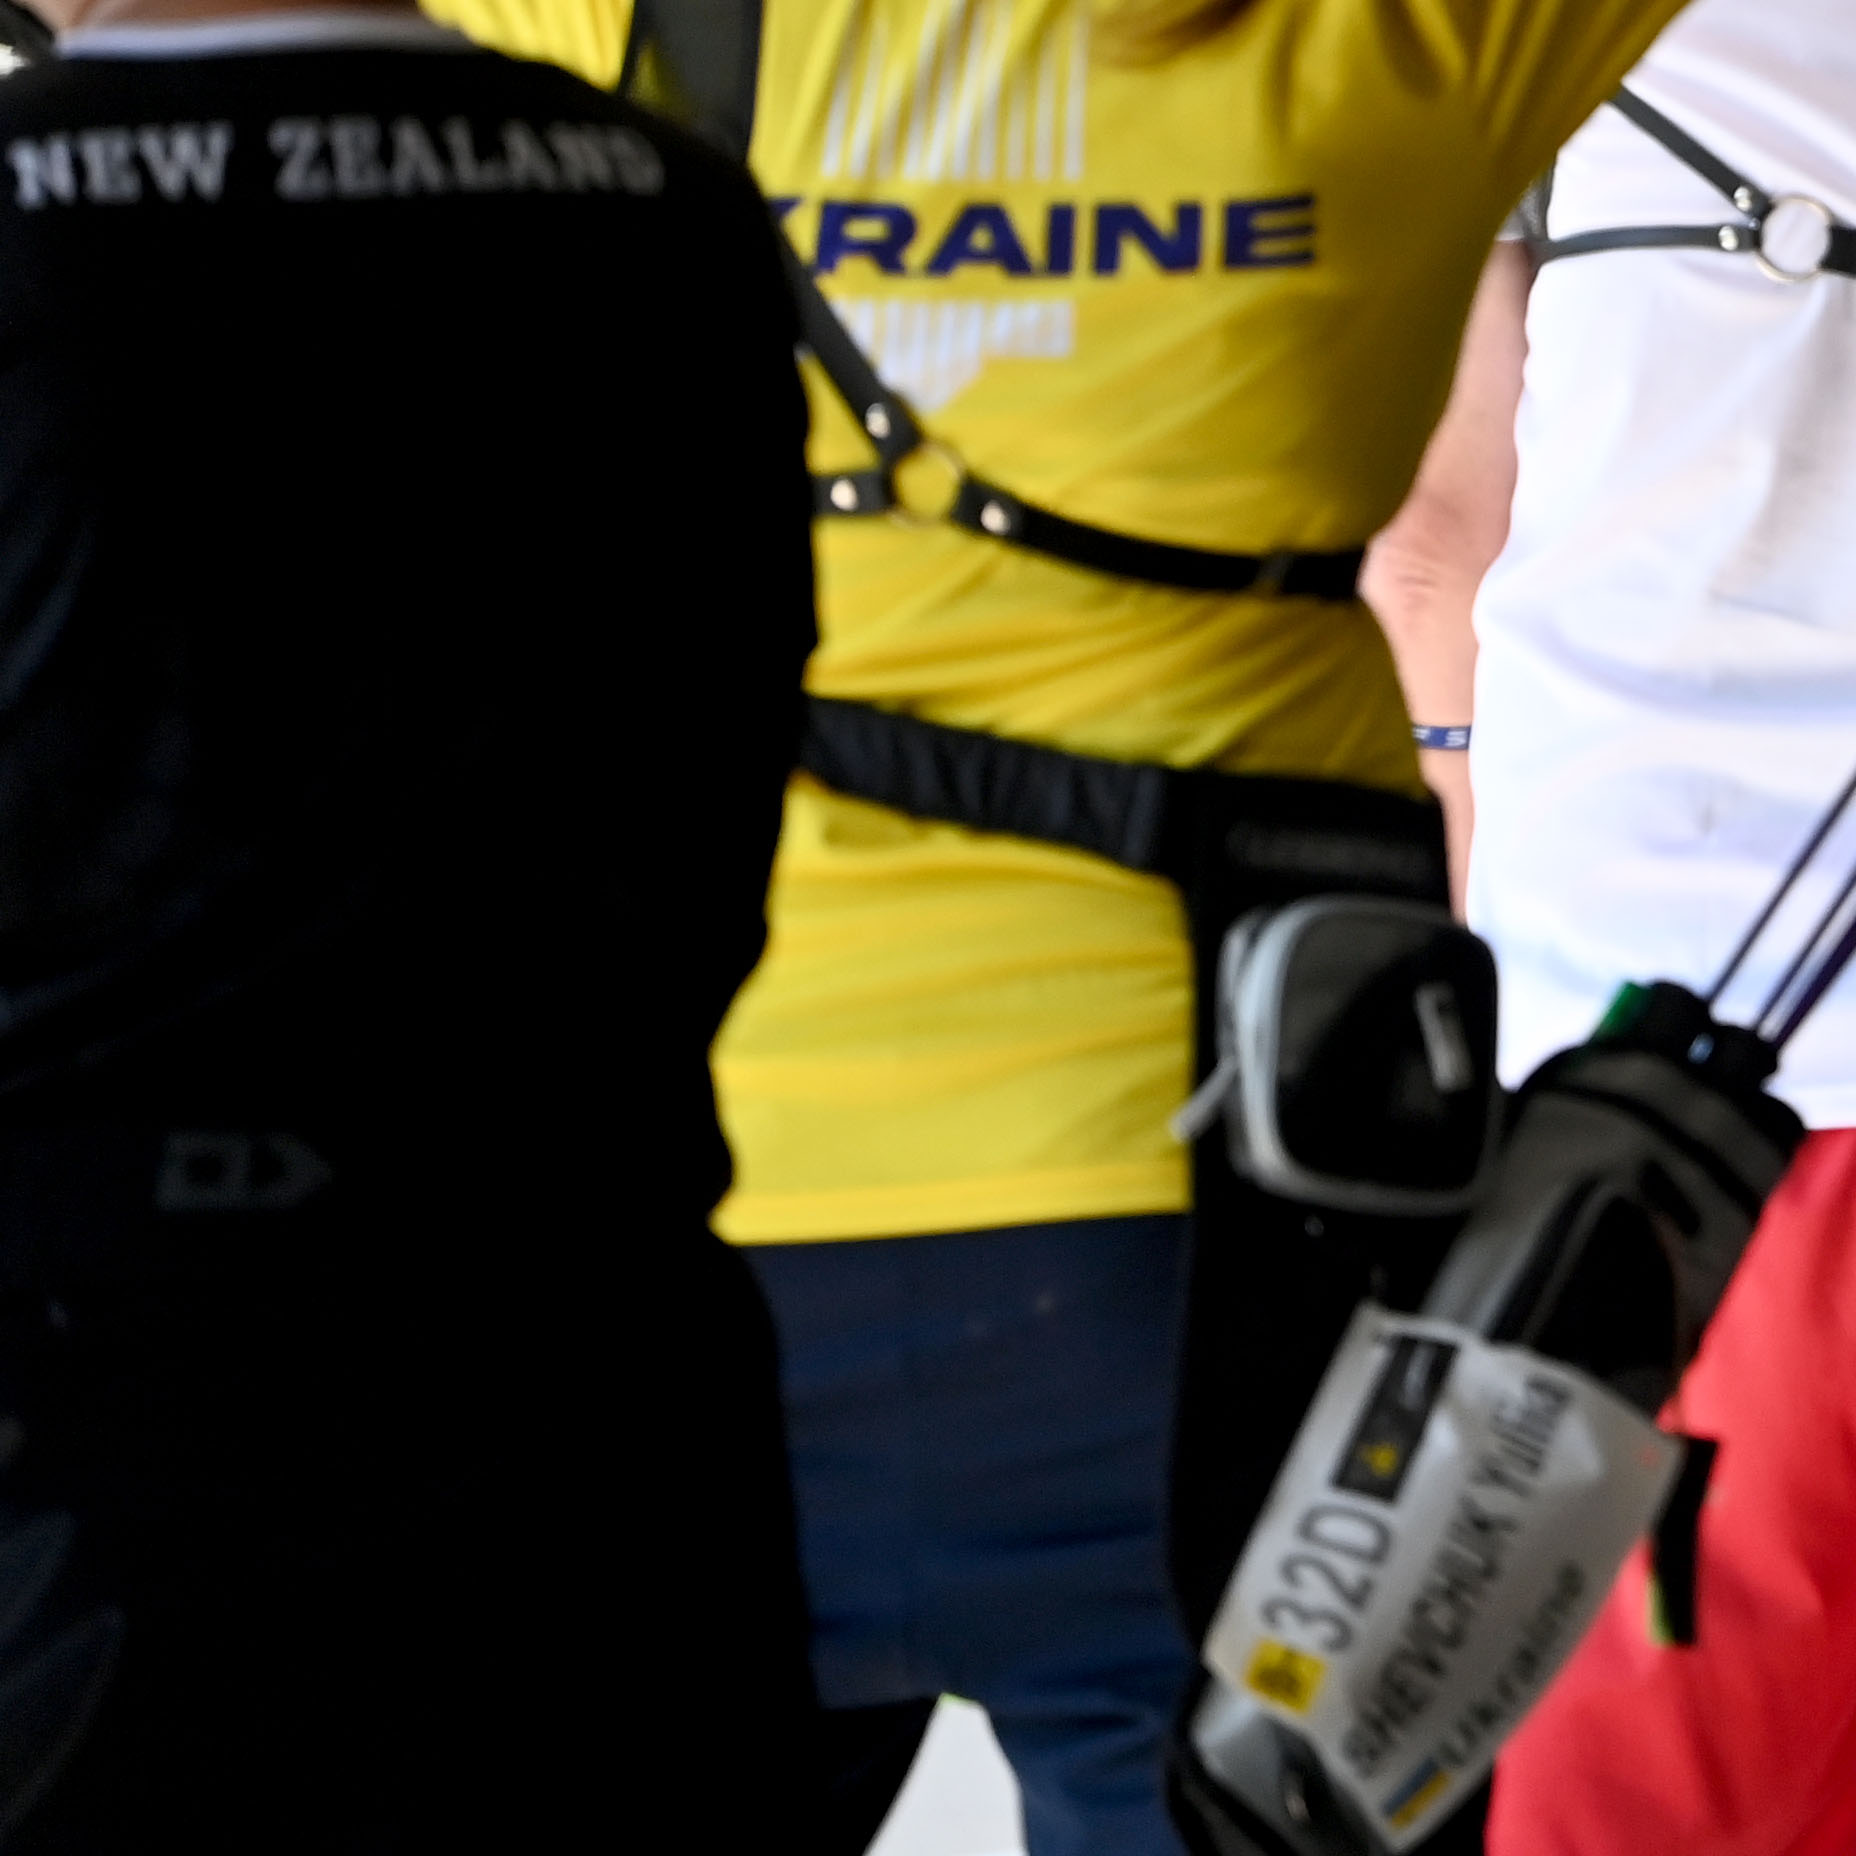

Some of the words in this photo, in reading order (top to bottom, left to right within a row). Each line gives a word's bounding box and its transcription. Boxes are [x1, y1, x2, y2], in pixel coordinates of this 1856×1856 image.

[6, 124, 235, 211] NEW
[268, 115, 666, 199] ZEALAND
[1261, 1499, 1397, 1655] 32D
